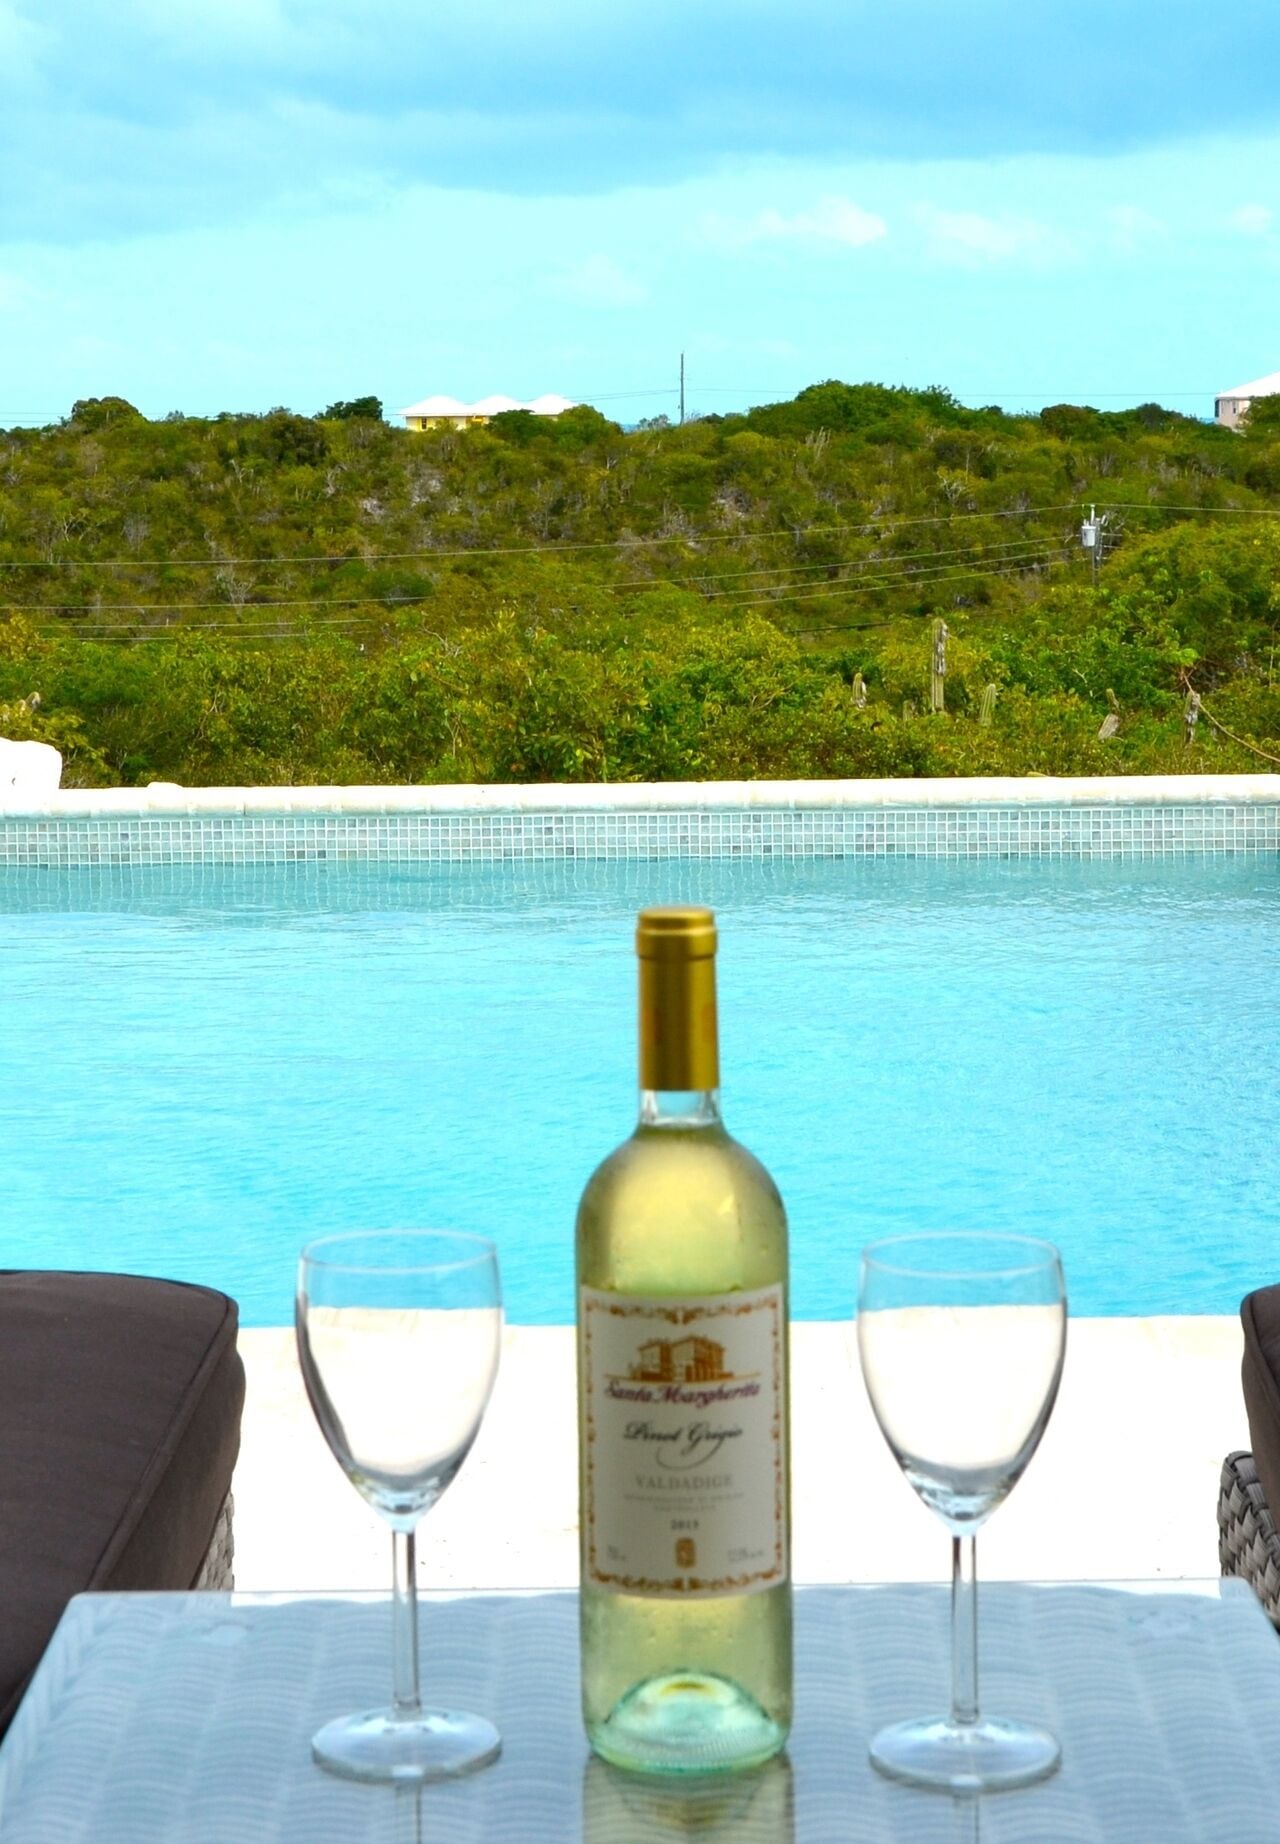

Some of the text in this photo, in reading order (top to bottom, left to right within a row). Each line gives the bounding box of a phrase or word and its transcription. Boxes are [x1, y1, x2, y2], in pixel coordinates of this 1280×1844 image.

[605, 1380, 653, 1402] Santa
[623, 1420, 682, 1442] Pinot
[635, 1474, 733, 1490] VALDADIGE
